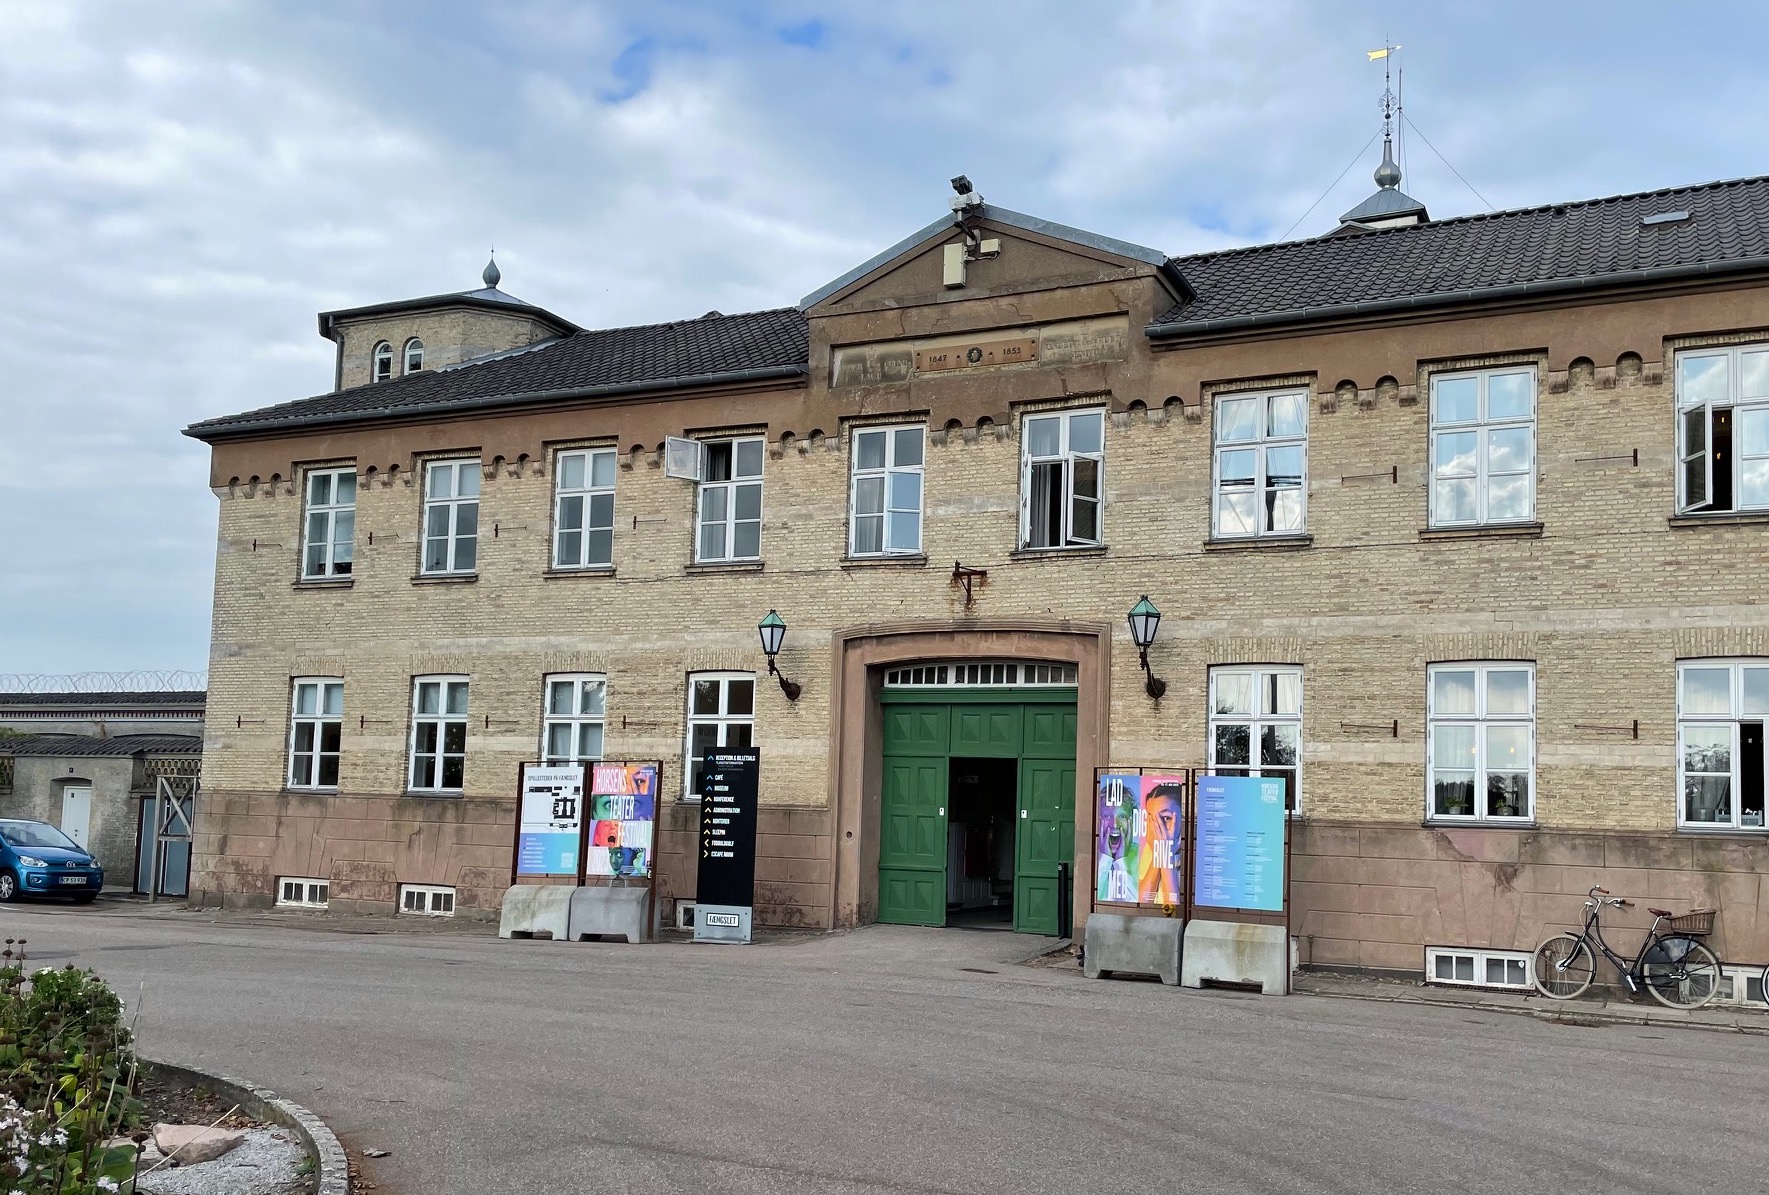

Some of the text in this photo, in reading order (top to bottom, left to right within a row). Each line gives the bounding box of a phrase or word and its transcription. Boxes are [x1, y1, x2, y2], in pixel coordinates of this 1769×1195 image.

[929, 354, 948, 363] 1847
[1003, 346, 1021, 356] 1853
[596, 768, 628, 793] HORSENS
[714, 773, 724, 781] CAFÉ
[1105, 778, 1123, 807] LAD
[609, 795, 635, 820] TEATER
[617, 821, 648, 847] FESTIVAL
[1132, 808, 1148, 838] DIG
[1152, 839, 1174, 869] RIVE
[1107, 869, 1128, 899] MED
[709, 915, 737, 925] FÆNGSLET
